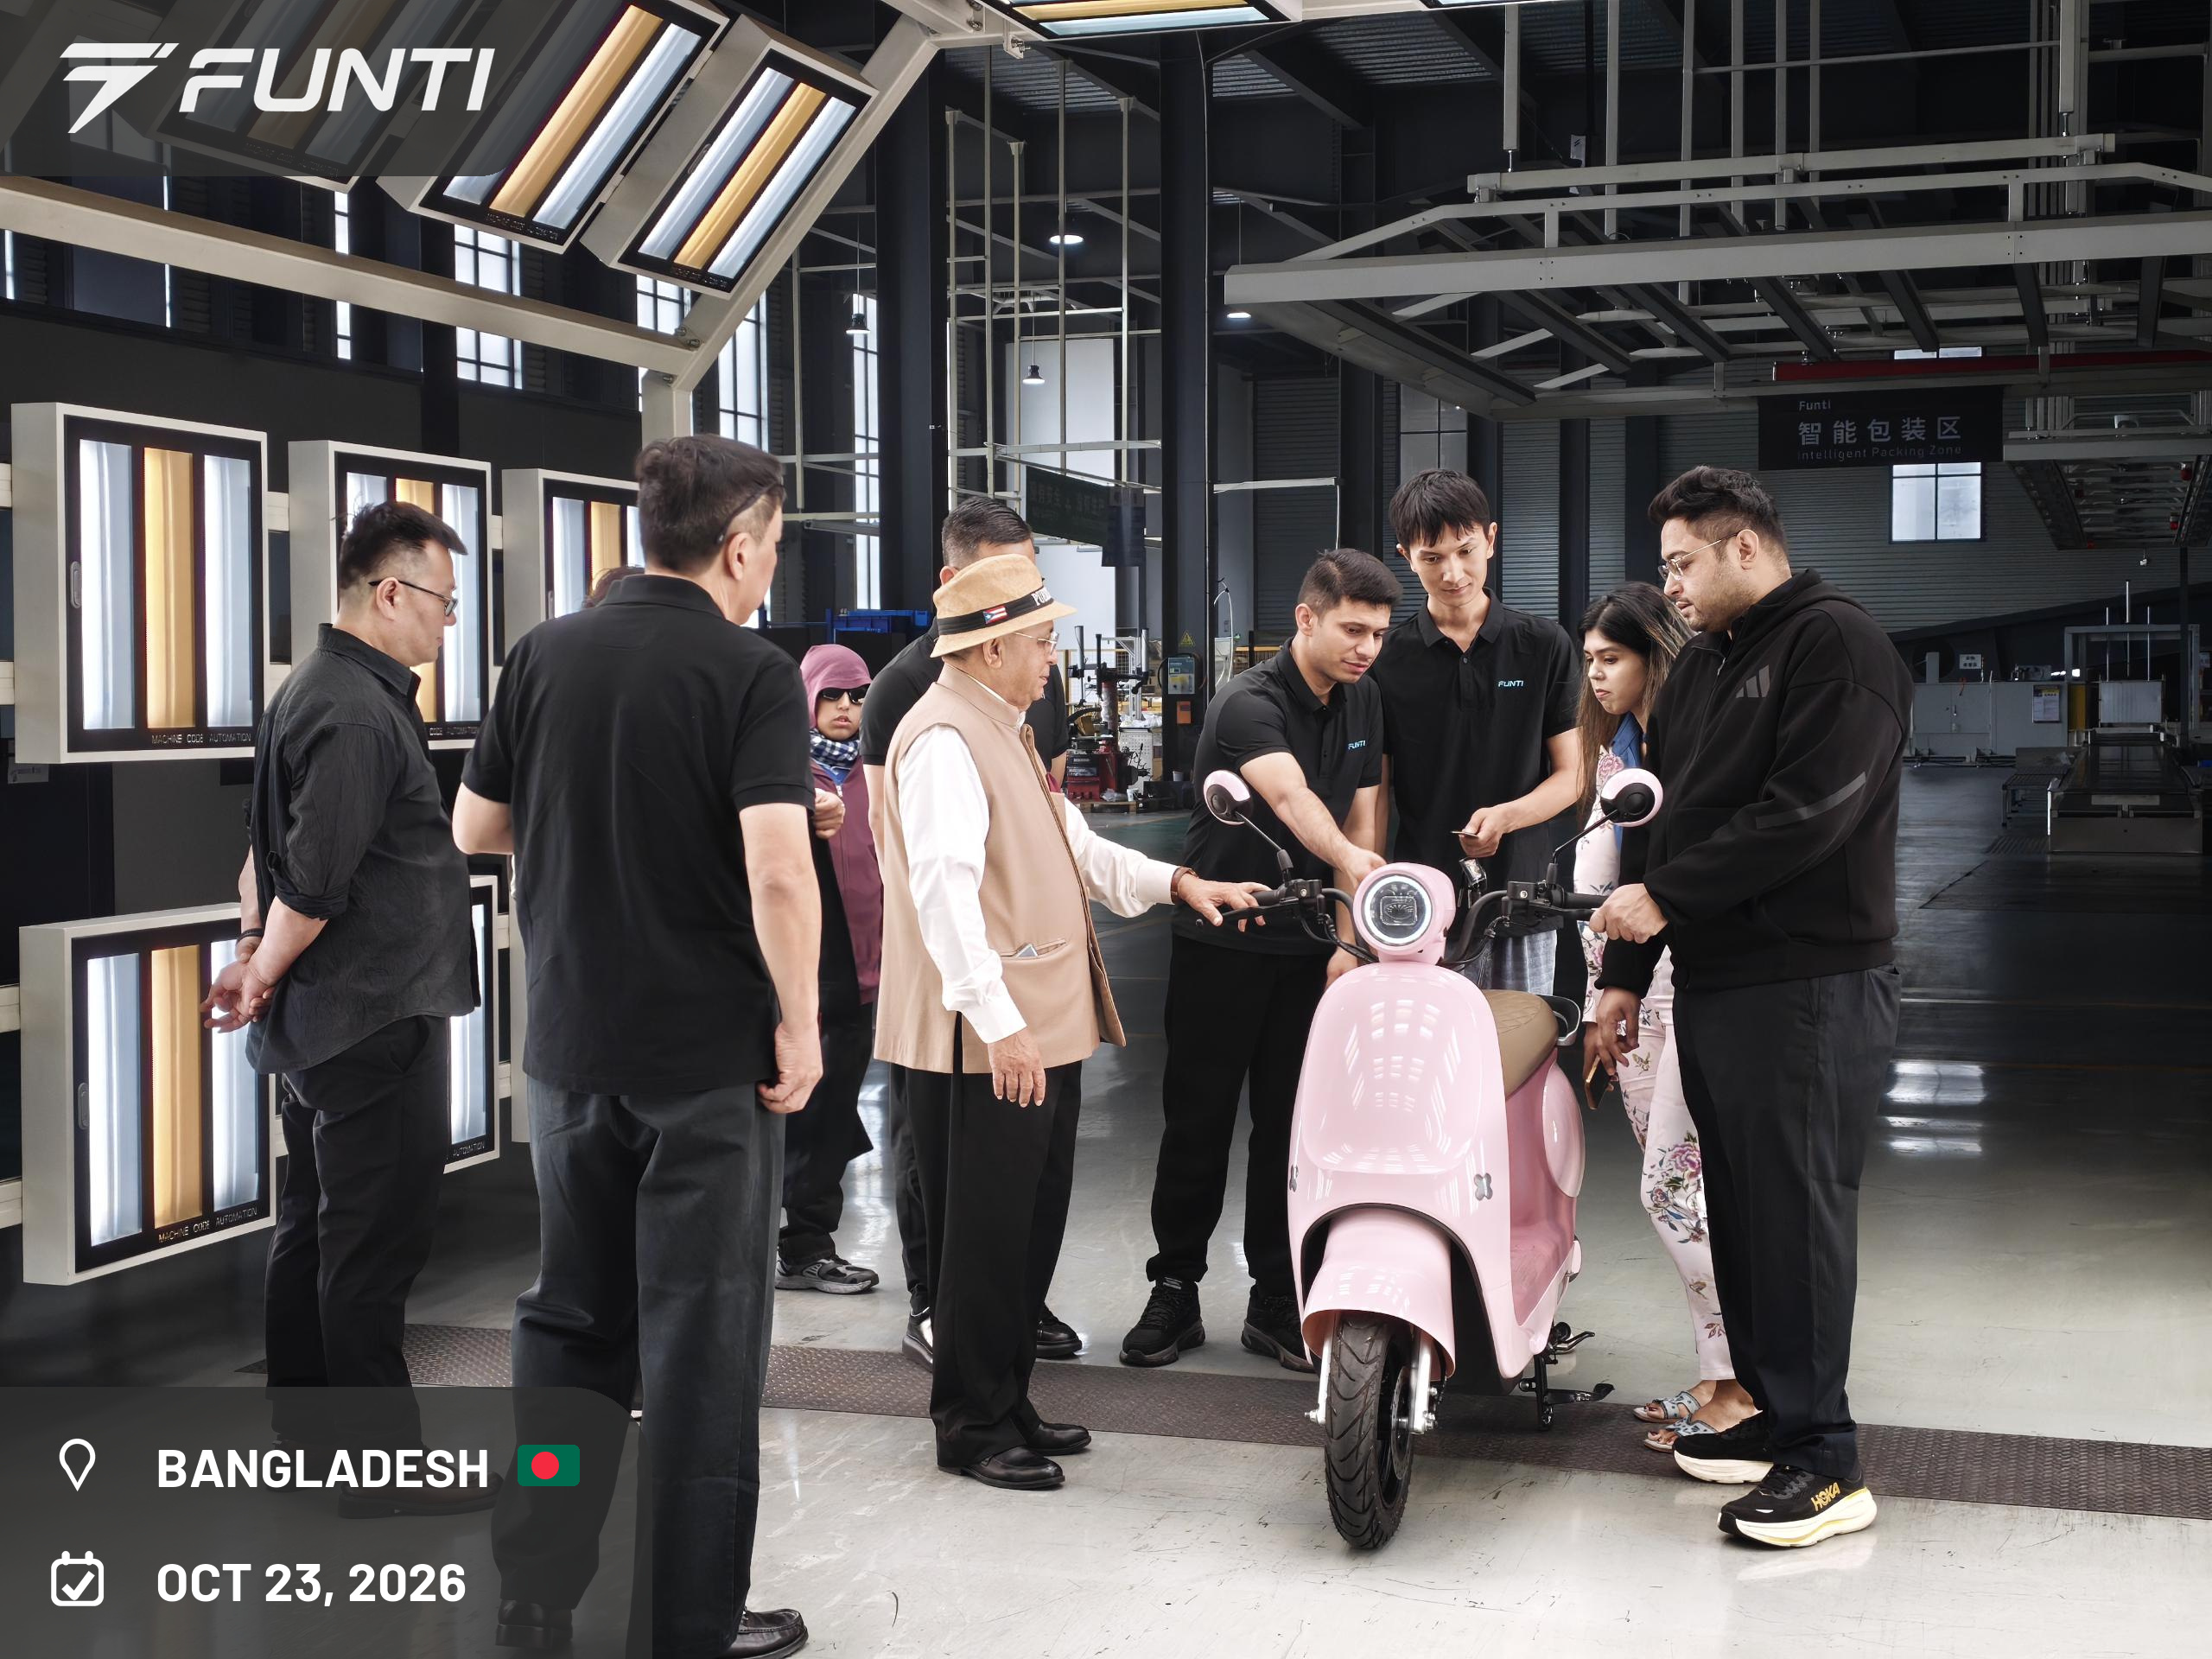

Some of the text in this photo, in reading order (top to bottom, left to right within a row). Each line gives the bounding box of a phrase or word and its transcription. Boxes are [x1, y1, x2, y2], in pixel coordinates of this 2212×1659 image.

[1798, 416, 1961, 446] 智能包装区
[1872, 446, 1924, 458] Packing
[1929, 444, 1961, 456] Zone
[151, 732, 252, 744] MACHINE CODE AUTOMATION
[158, 1206, 258, 1243] MACHINE CODE AUTOMATION
[1810, 1482, 1840, 1511] HOKA
